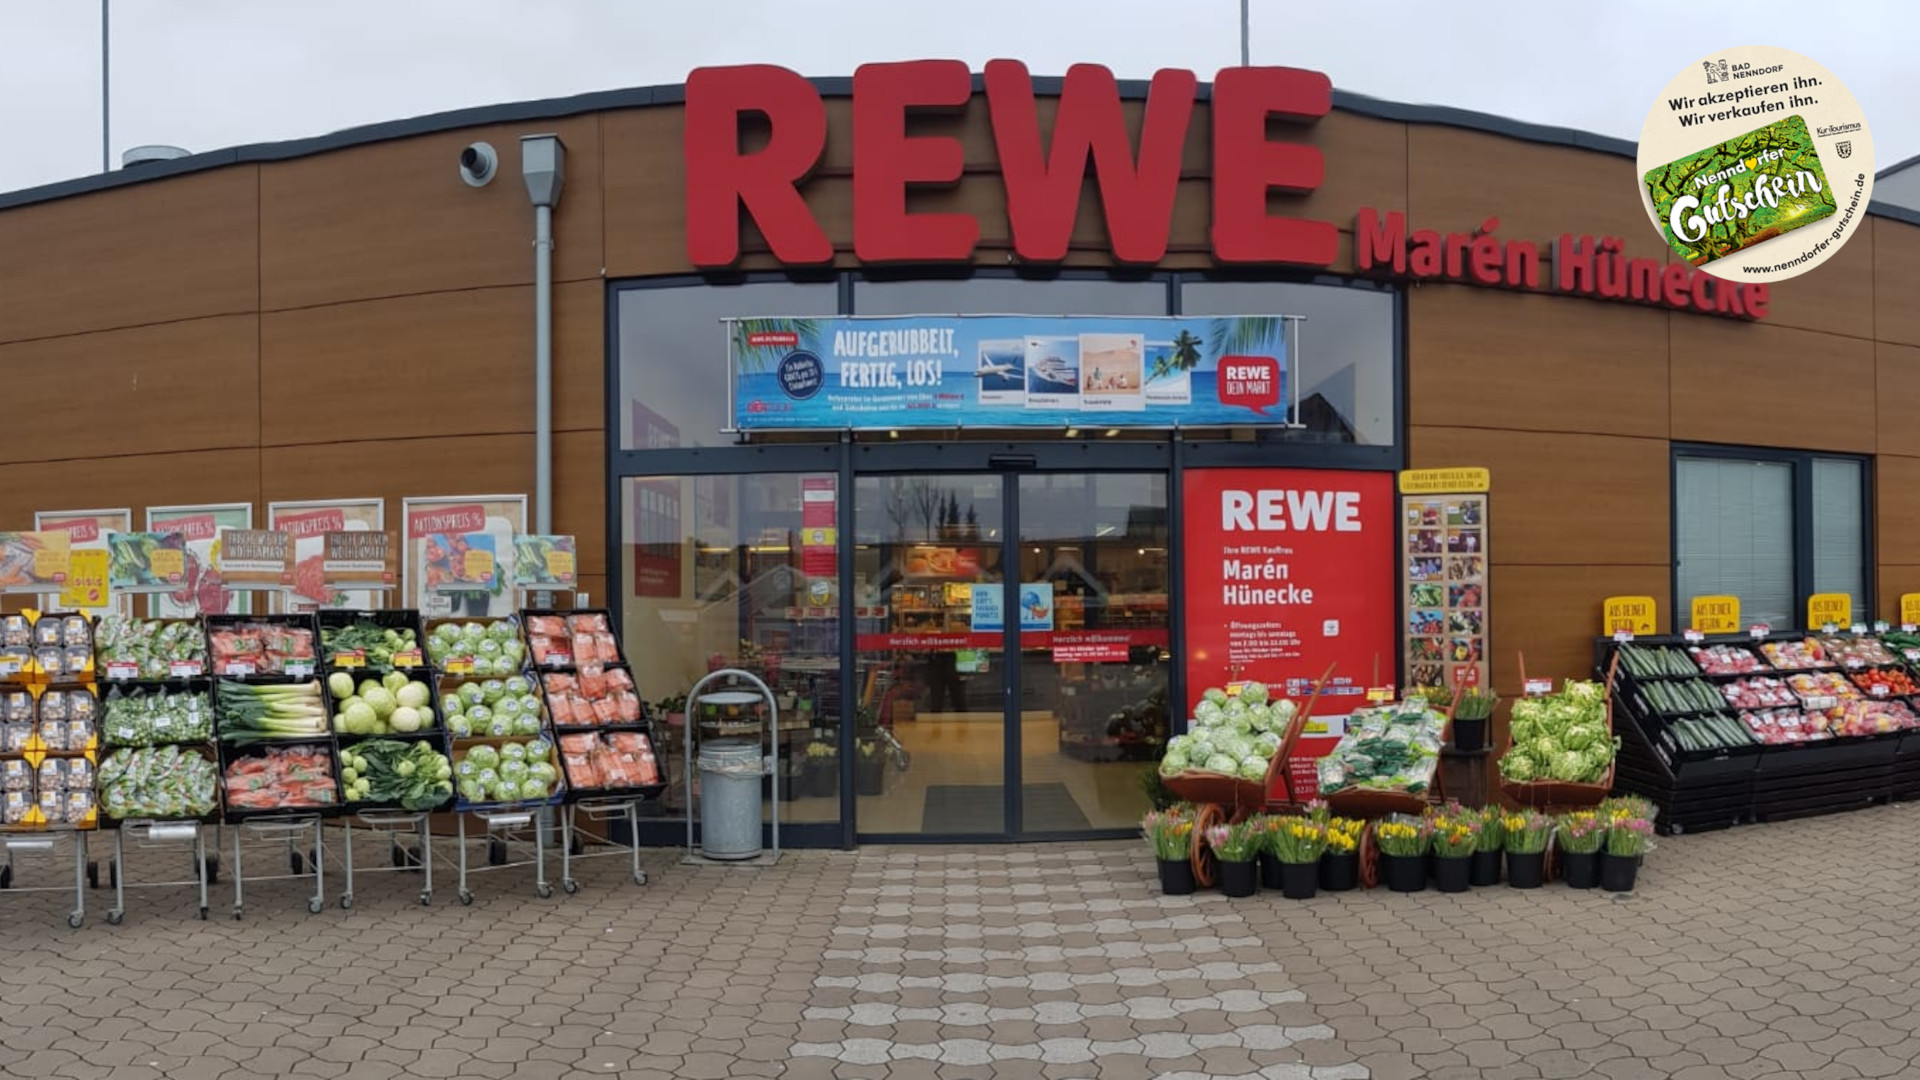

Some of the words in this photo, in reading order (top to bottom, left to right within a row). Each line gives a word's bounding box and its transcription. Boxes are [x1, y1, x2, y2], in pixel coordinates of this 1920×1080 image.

[685, 59, 1338, 266] REWE
[1356, 207, 1539, 288] Marén
[834, 328, 959, 358] AUFGERUBBELT,
[840, 360, 902, 390] FERTIG,
[907, 360, 942, 387] LOS!
[1226, 366, 1270, 380] REWE
[1226, 381, 1244, 395] DEIN
[1246, 381, 1270, 394] MARKT
[1222, 490, 1362, 531] REWE
[413, 512, 471, 532] AKTIONSPREIS
[1224, 558, 1288, 580] Marén
[1224, 583, 1313, 606] Hünecke
[890, 638, 918, 646] Herzlich
[1053, 636, 1082, 644] Herzlich
